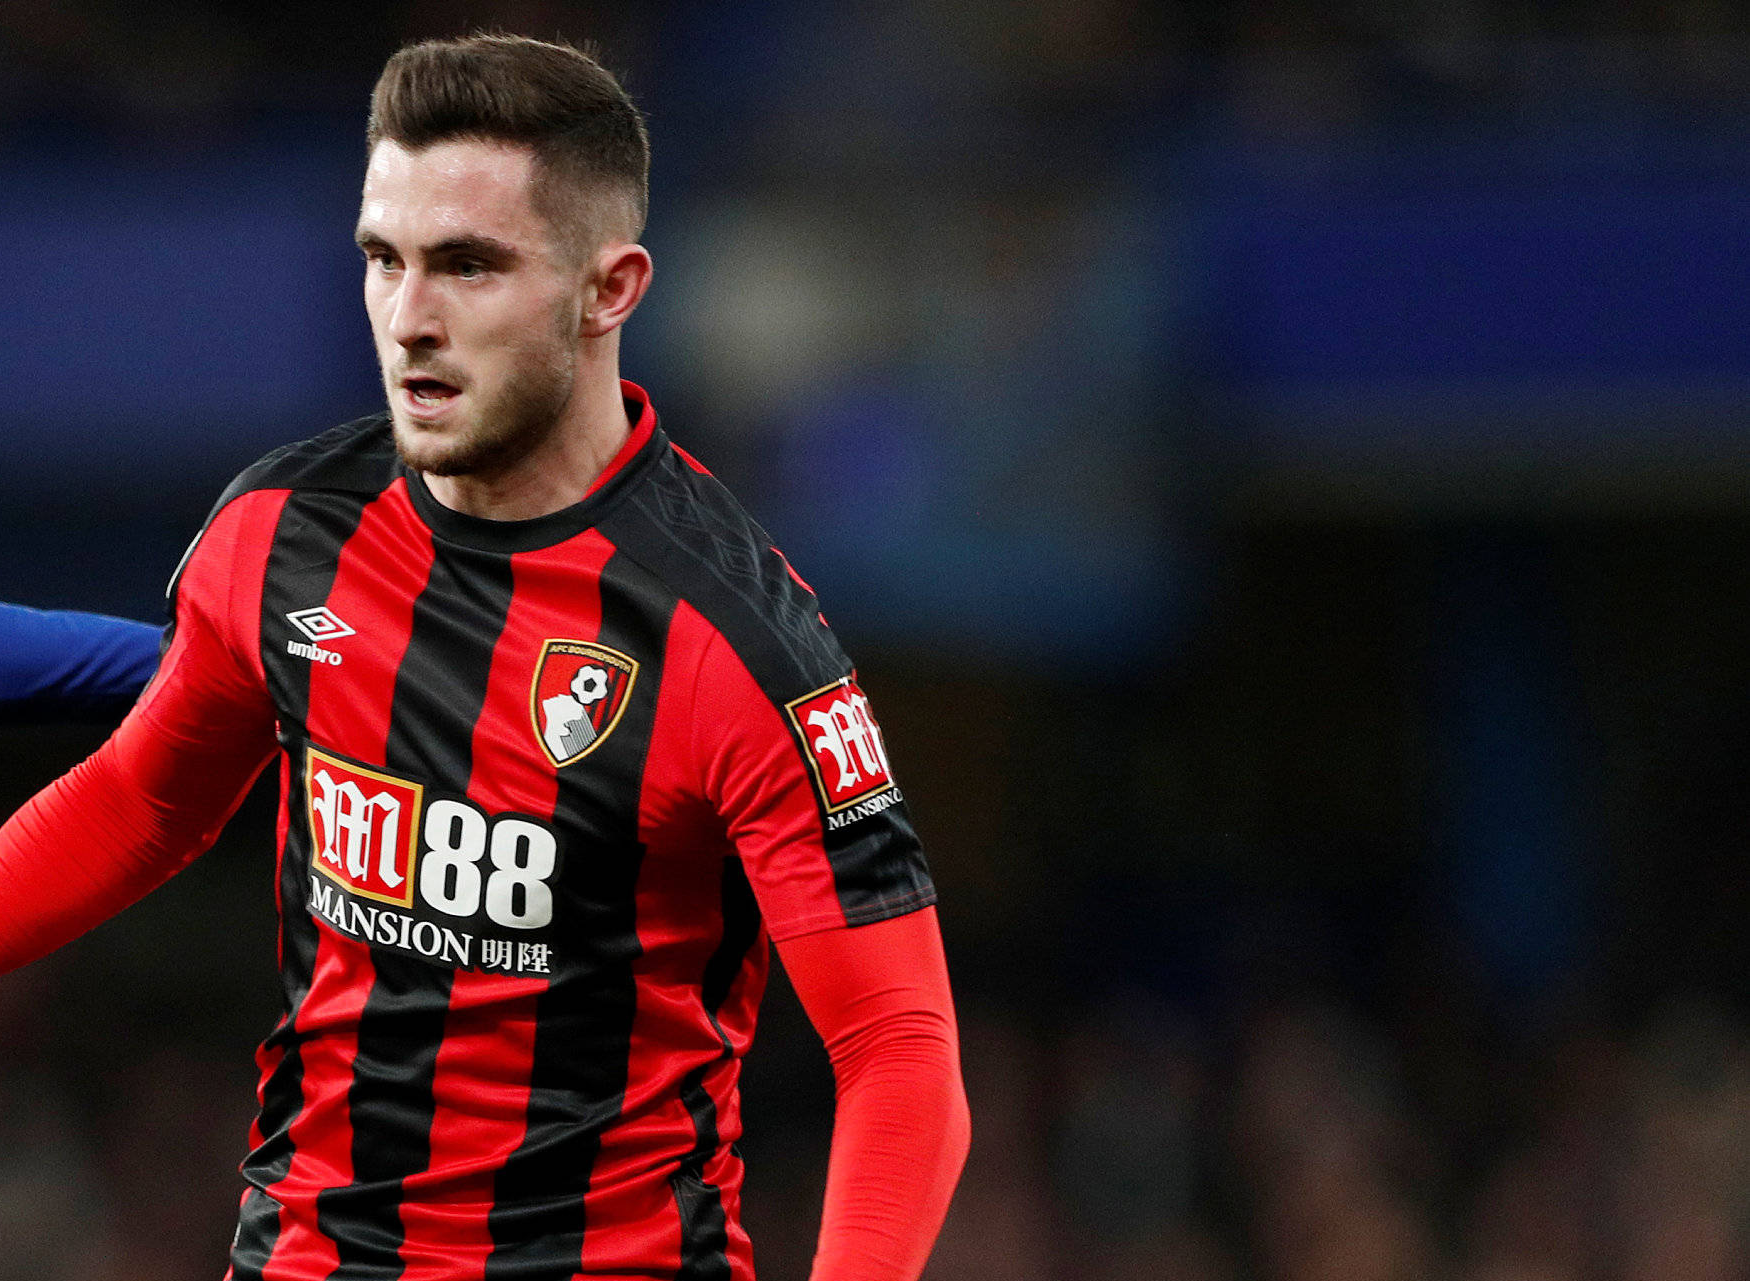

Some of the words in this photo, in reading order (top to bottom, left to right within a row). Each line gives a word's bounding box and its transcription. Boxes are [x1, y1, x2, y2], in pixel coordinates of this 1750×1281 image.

[286, 639, 342, 666] umbro
[420, 799, 557, 930] 88
[310, 876, 474, 966] MANSION
